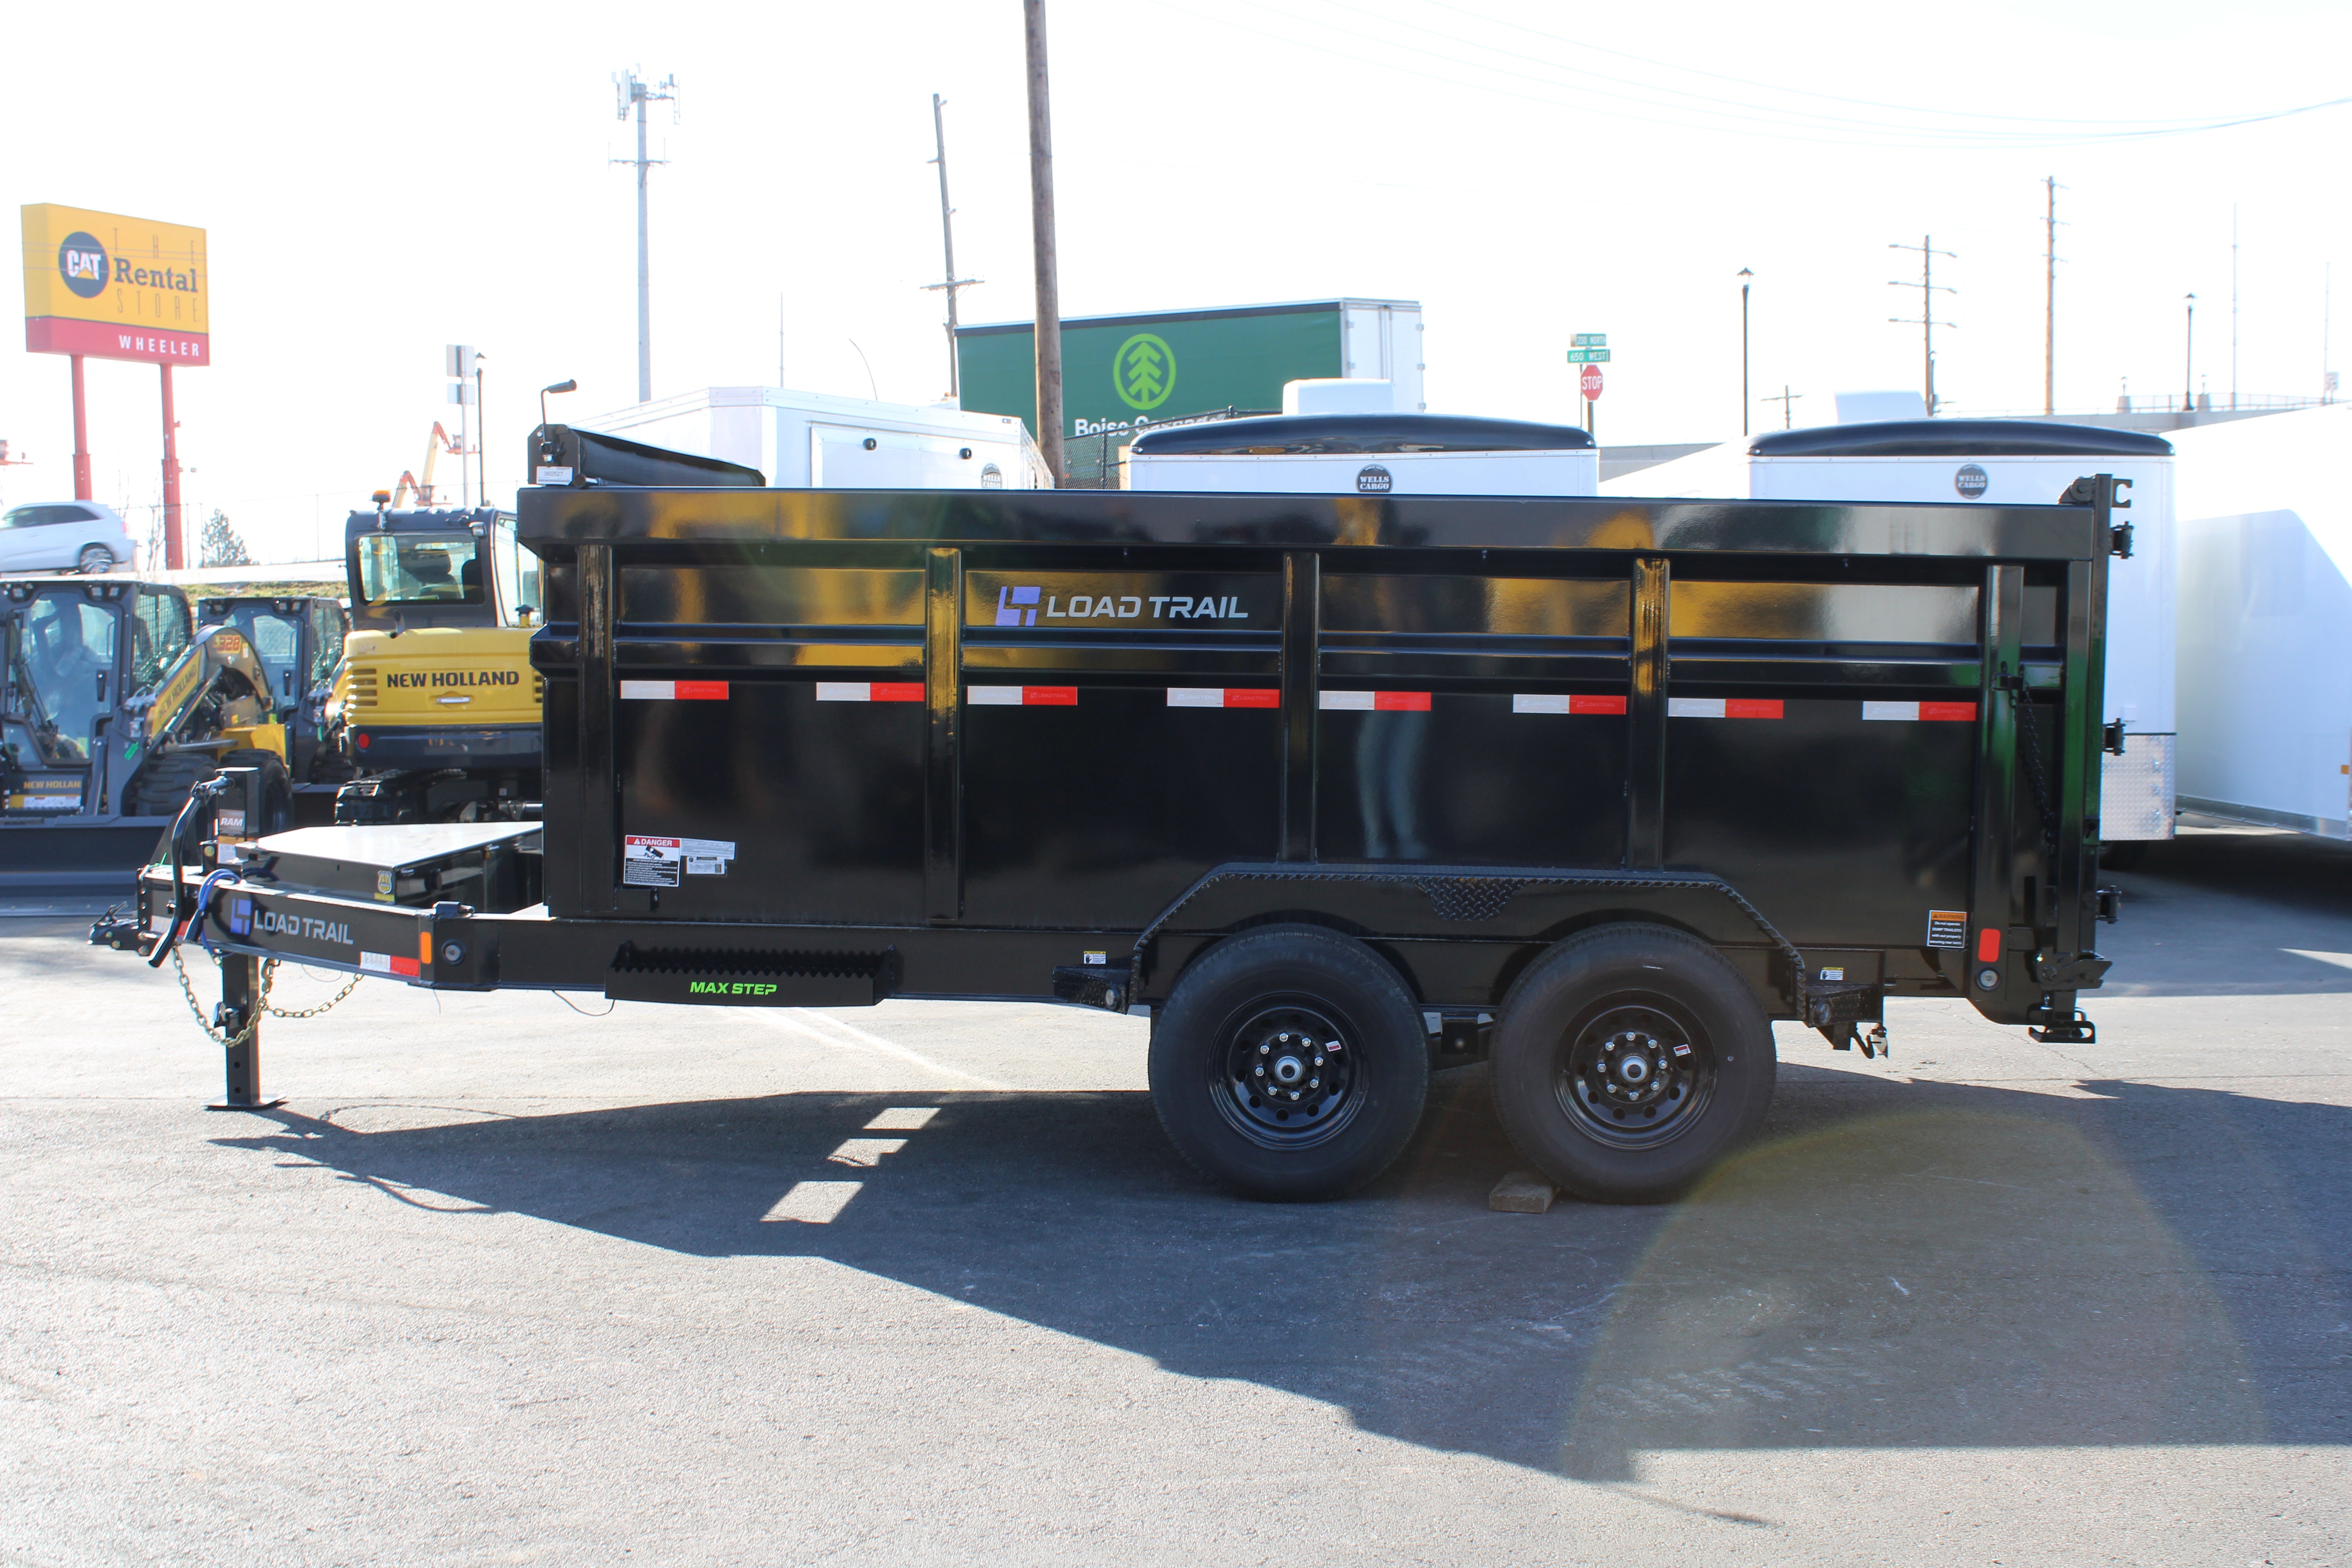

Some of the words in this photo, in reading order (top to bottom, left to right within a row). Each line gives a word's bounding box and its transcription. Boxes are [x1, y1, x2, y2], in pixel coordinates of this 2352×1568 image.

[67, 249, 102, 281] CAT
[114, 257, 198, 293] Rental
[119, 335, 199, 356] WHEELER
[1570, 353, 1584, 361] 650
[1588, 352, 1606, 361] WEST
[1582, 375, 1602, 390] STOP
[1047, 596, 1141, 618] LOAD
[1148, 597, 1249, 618] TRAIL
[387, 673, 427, 687] NEW
[432, 671, 519, 686] HOLLAND
[23, 781, 45, 789] NEW
[46, 780, 82, 788] HOLLAN
[220, 817, 244, 826] RAM
[641, 838, 673, 846] DANGER
[254, 910, 300, 935] LOAD
[302, 918, 354, 945] TRAIL
[690, 981, 728, 994] MAX
[731, 983, 777, 996] STEP
